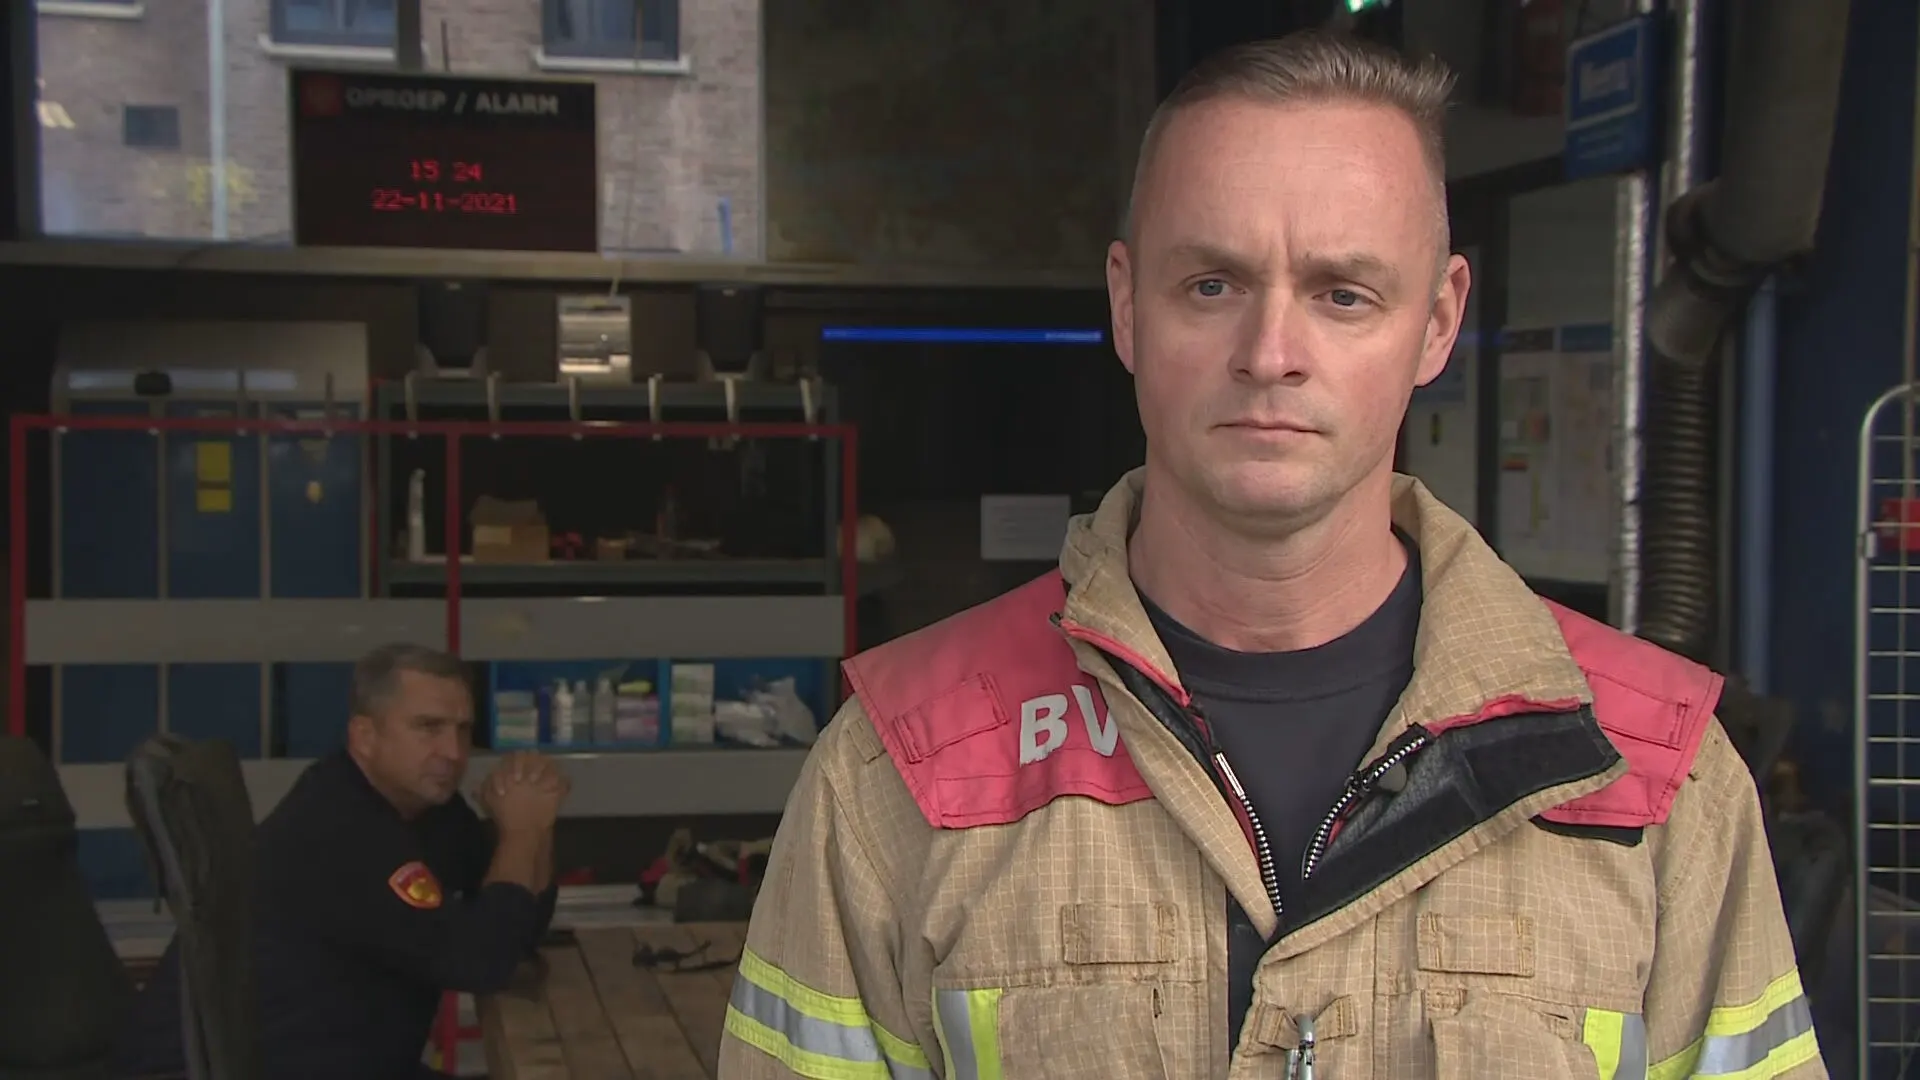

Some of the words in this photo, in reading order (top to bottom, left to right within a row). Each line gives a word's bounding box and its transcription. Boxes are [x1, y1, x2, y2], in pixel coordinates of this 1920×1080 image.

[347, 87, 446, 111] OPROEP
[454, 91, 468, 114] /
[475, 92, 559, 114] ALARM
[409, 159, 440, 181] 15
[452, 161, 482, 182] 24
[373, 190, 516, 213] 22-11-2021
